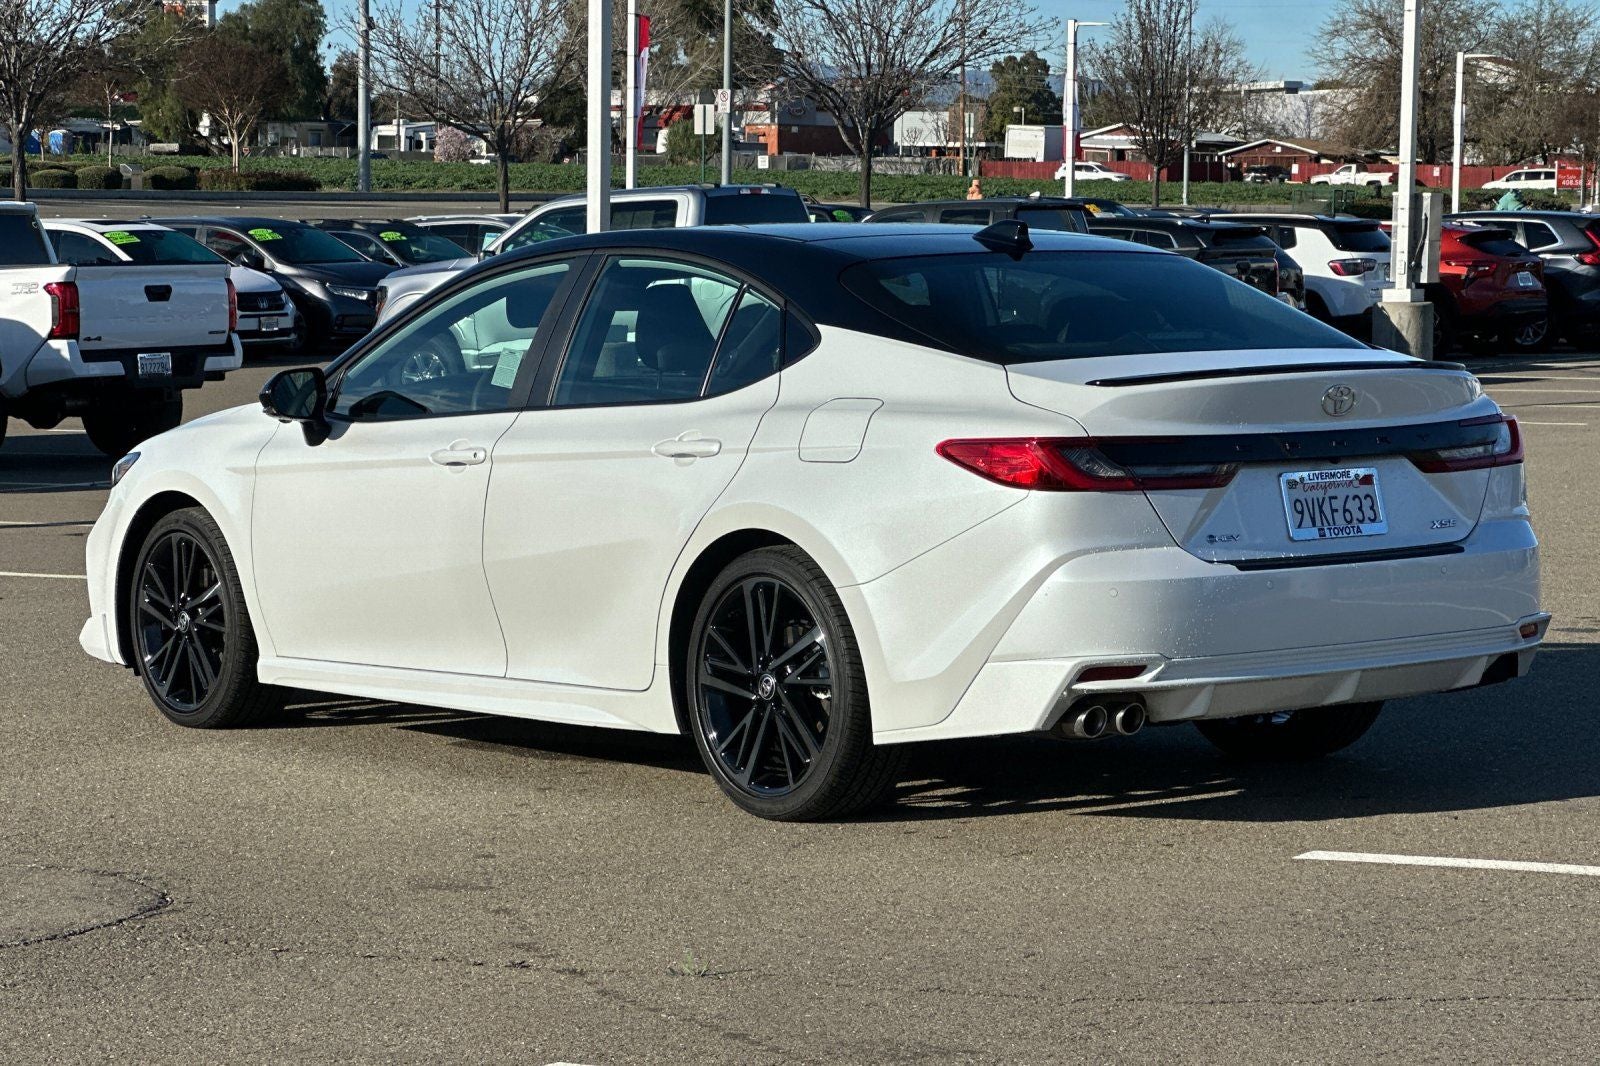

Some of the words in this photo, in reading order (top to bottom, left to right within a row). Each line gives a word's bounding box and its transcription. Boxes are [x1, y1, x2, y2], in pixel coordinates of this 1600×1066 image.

[11, 282, 39, 291] TRD
[1308, 470, 1351, 481] LIVERMORE
[1294, 494, 1377, 528] 9VKF633
[1327, 525, 1363, 537] TOYOTA
